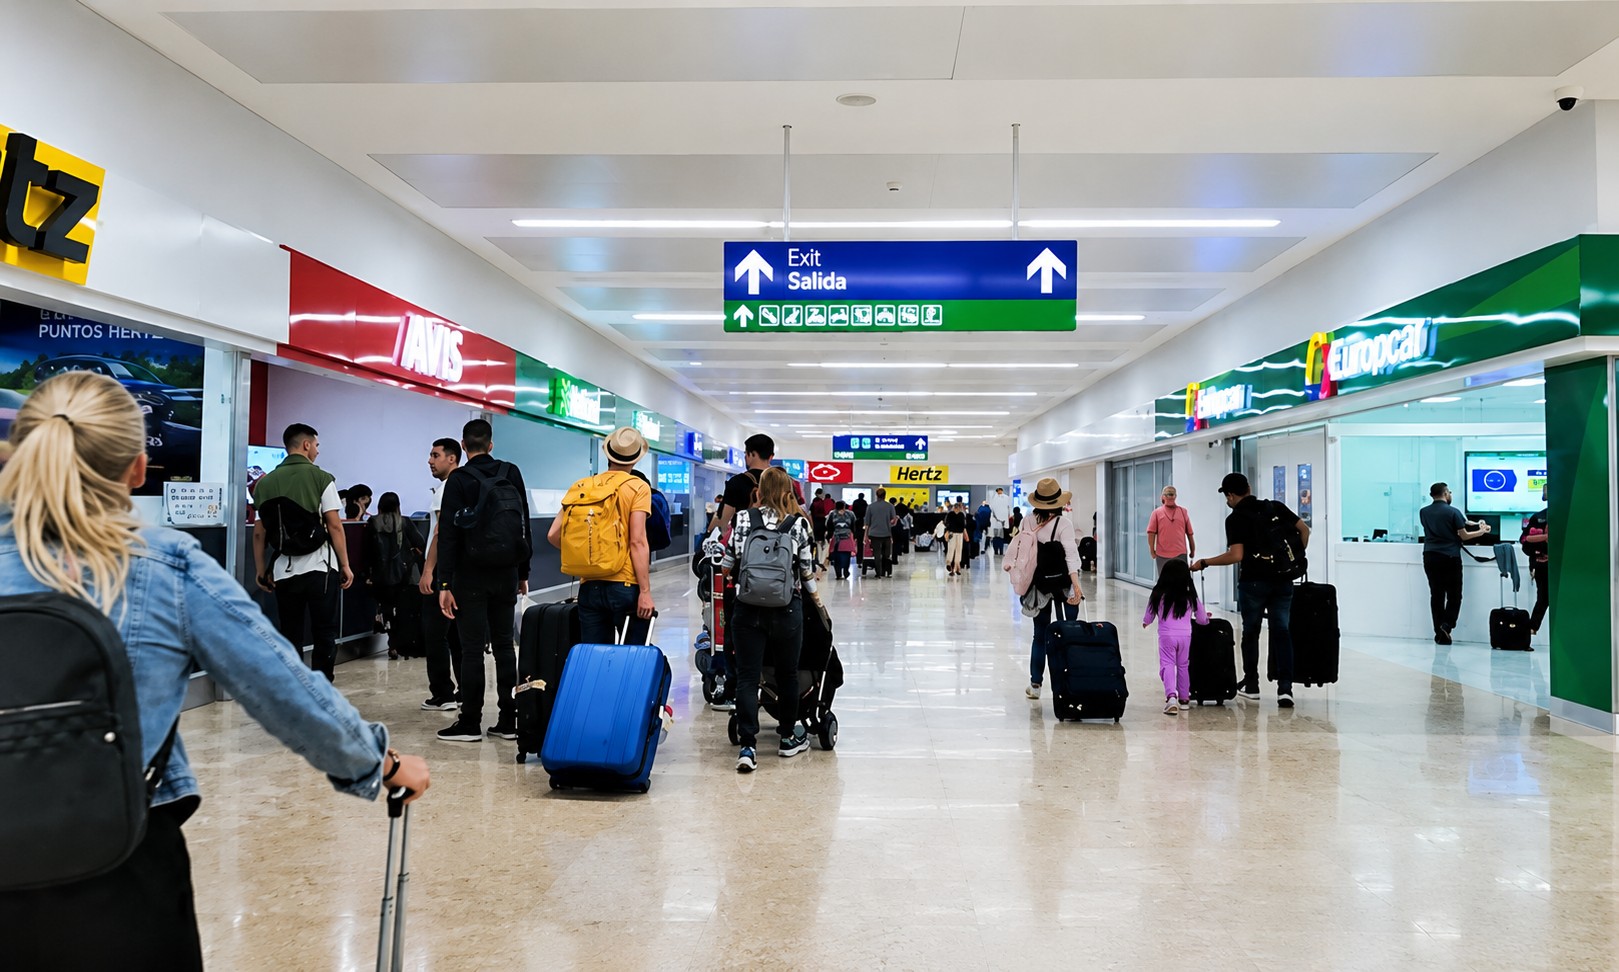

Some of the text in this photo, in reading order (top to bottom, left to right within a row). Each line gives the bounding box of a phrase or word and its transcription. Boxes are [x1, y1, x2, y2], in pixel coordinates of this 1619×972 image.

[788, 248, 822, 267] Exit
[788, 271, 847, 290] Salida
[39, 324, 164, 339] PUNTOS HER
[401, 313, 464, 383] AVIS
[1328, 320, 1428, 381] Europcar
[897, 466, 943, 481] Hertz
